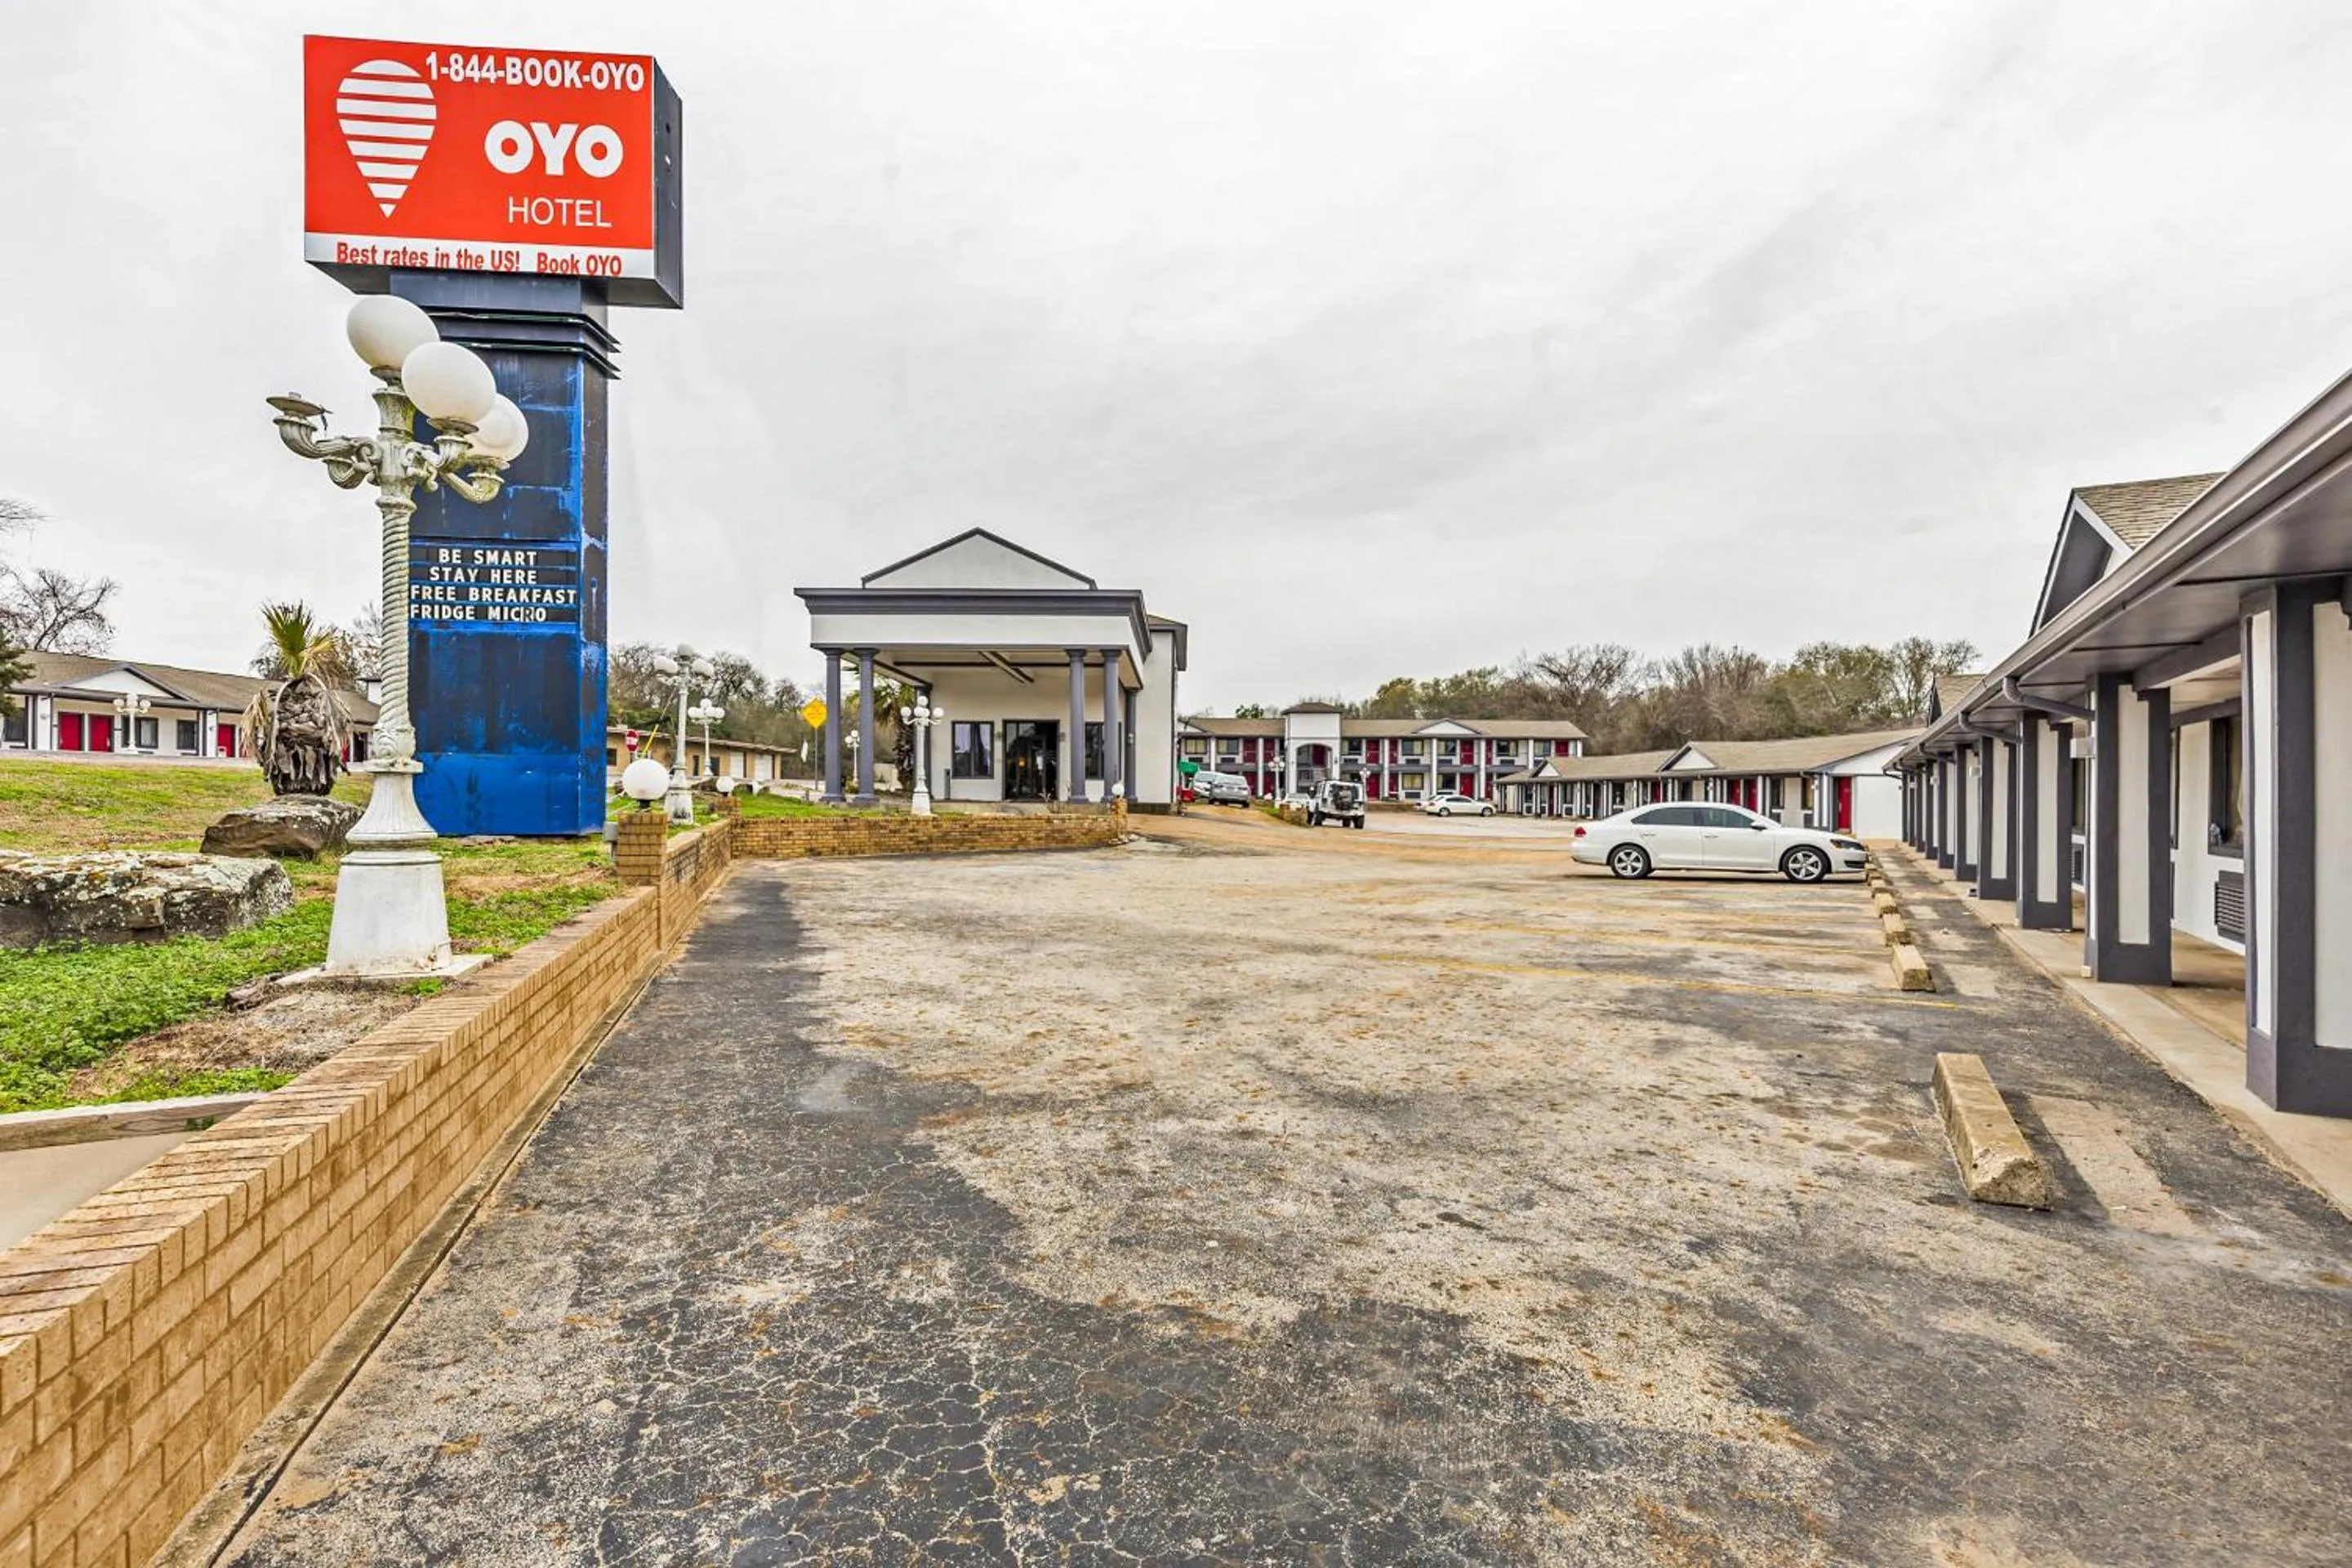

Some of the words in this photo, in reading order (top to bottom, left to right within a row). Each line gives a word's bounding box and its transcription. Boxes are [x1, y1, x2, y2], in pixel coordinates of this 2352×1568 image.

[425, 51, 645, 92] 1-844-BOOK-OYO
[484, 120, 624, 178] OYO
[508, 197, 612, 228] HOTEL
[336, 242, 376, 265] Best
[383, 245, 429, 268] rates
[434, 247, 449, 269] in
[457, 248, 484, 270] the
[490, 250, 520, 271] US!
[537, 252, 580, 275] Book
[586, 254, 622, 276] OYO
[439, 548, 461, 564] BE
[474, 550, 537, 565] SMART
[430, 567, 479, 582] STAY
[491, 569, 537, 585] HERE
[411, 585, 456, 600] FREE
[468, 587, 577, 604] BREAKFAST
[411, 604, 475, 620] FRIDGE
[488, 606, 546, 622] MICRO
